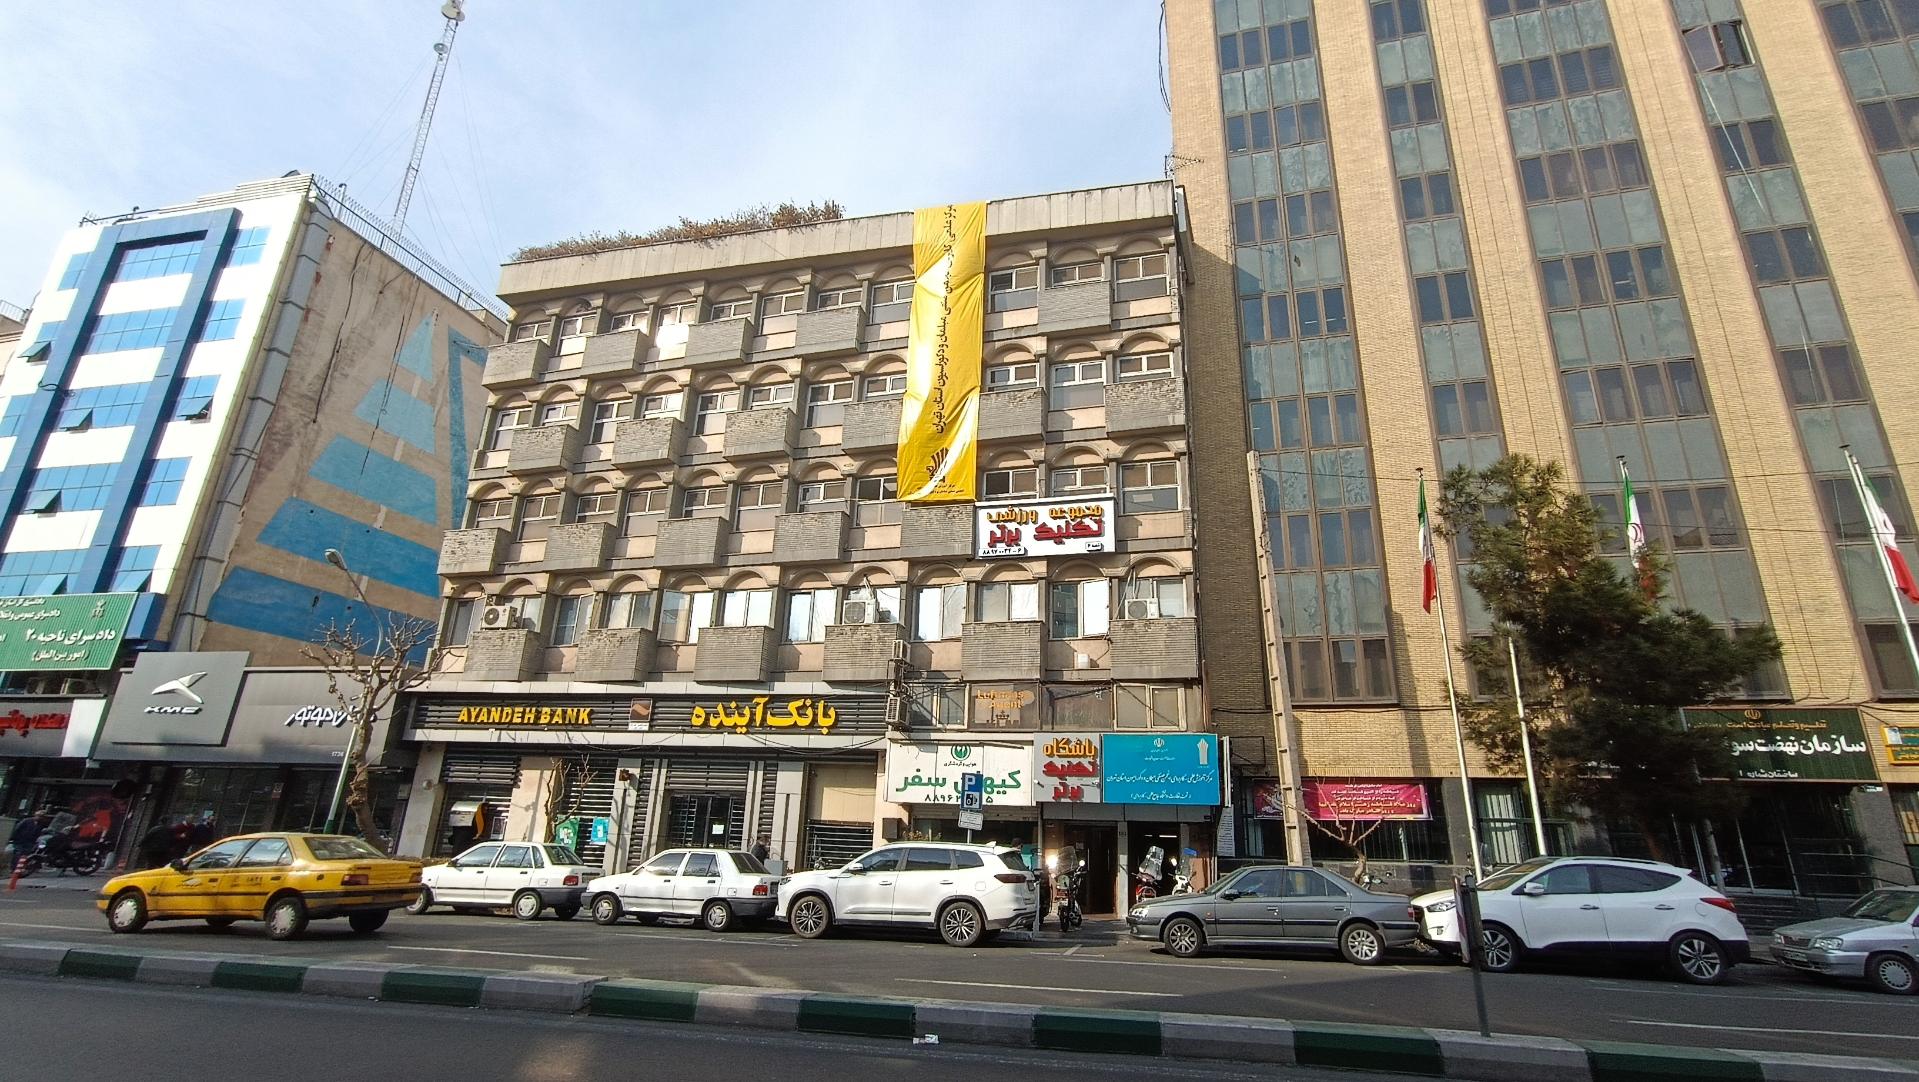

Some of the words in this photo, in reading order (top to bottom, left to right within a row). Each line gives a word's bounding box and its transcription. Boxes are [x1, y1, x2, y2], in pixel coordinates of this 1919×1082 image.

[934, 348, 950, 387] دکوراسیون
[932, 387, 946, 411] استان
[932, 411, 948, 434] تهران
[987, 505, 1039, 525] ورزشی
[1049, 503, 1104, 521] مجموعه
[987, 524, 1022, 547] برتر
[36, 629, 67, 645] ناحیه
[144, 706, 200, 714] KMC
[284, 705, 334, 726] موتور
[457, 706, 536, 723] AYANDEH
[539, 707, 592, 724] BANK
[691, 696, 770, 734] آینده
[767, 698, 836, 735] بانک
[1043, 737, 1098, 760] باشگاه
[1754, 735, 1799, 756] نهضت
[1800, 734, 1867, 755] سازمان
[896, 768, 947, 793] سفر
[953, 770, 1022, 795] کیهن
[964, 775, 976, 791] P
[1747, 769, 1771, 778] شماره
[1769, 769, 1799, 778] ساختمان
